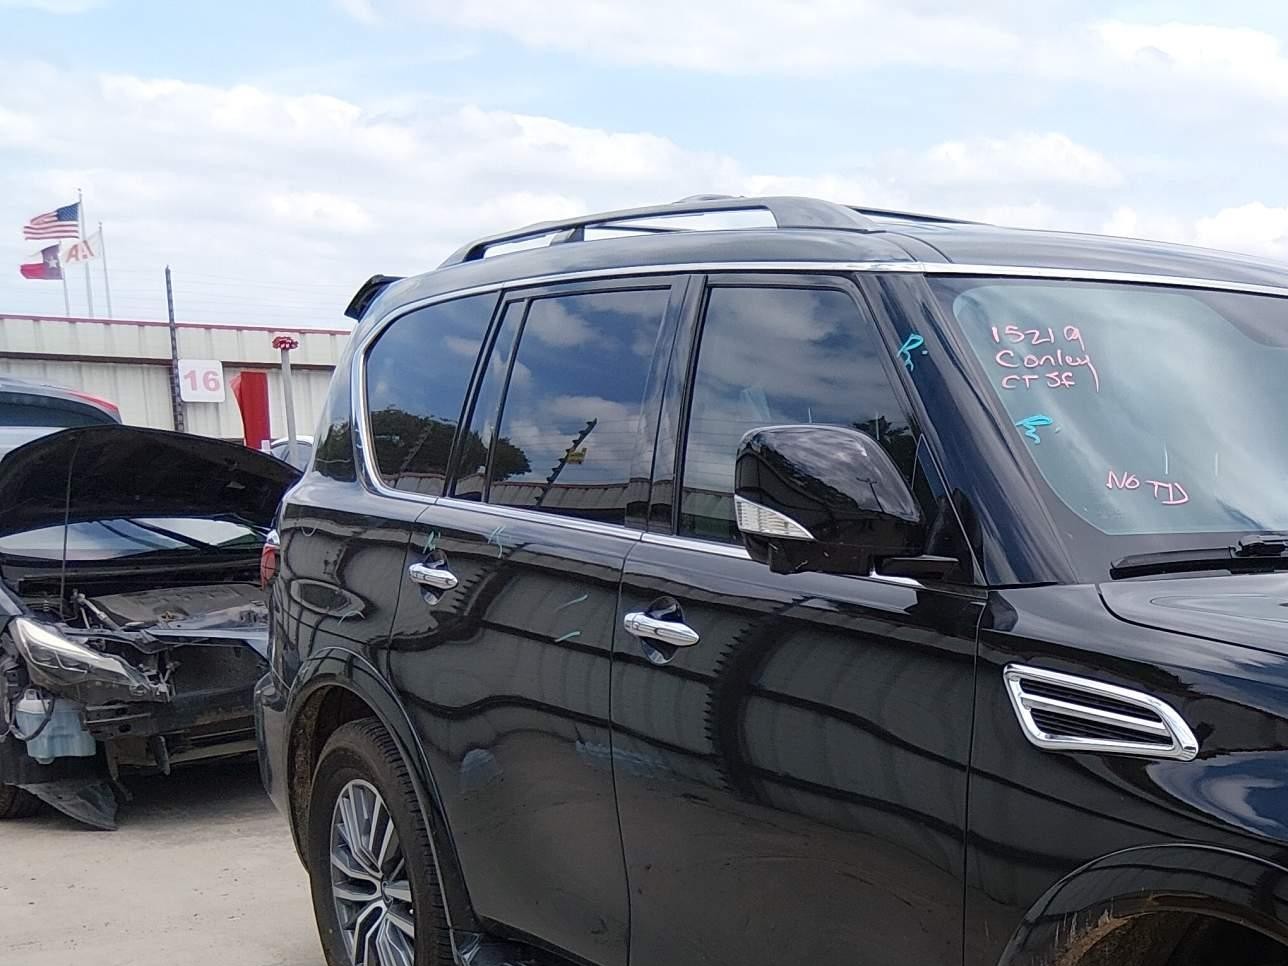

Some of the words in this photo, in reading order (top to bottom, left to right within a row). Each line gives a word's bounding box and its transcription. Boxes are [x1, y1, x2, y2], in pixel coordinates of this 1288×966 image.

[183, 369, 221, 392] 16
[995, 349, 1100, 392] Conley
[1001, 374, 1040, 389] CT
